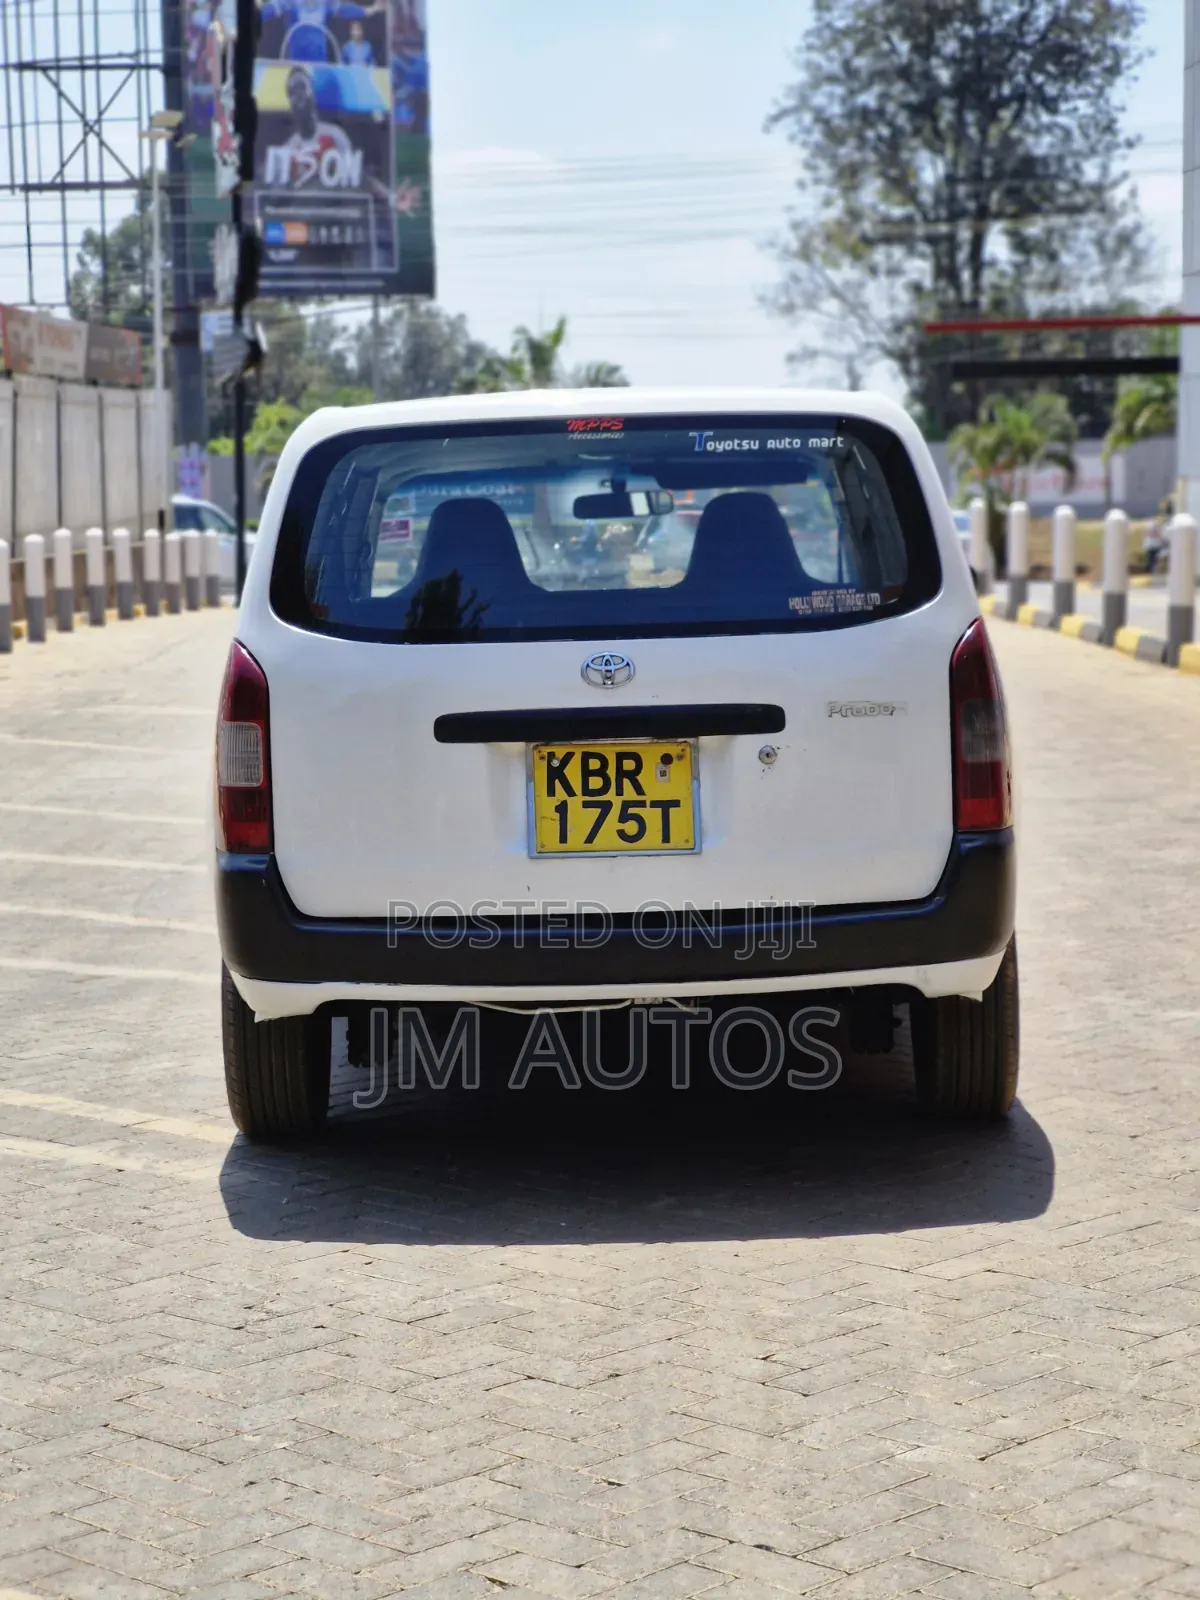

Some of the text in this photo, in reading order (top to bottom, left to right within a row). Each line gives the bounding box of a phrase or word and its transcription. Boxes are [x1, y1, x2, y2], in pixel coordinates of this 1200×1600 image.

[566, 416, 625, 432] MPPS
[689, 431, 759, 453] Toyotsu
[808, 436, 844, 448] mart
[867, 592, 880, 606] LTD
[546, 751, 647, 797] KBR
[554, 799, 681, 844] 175T
